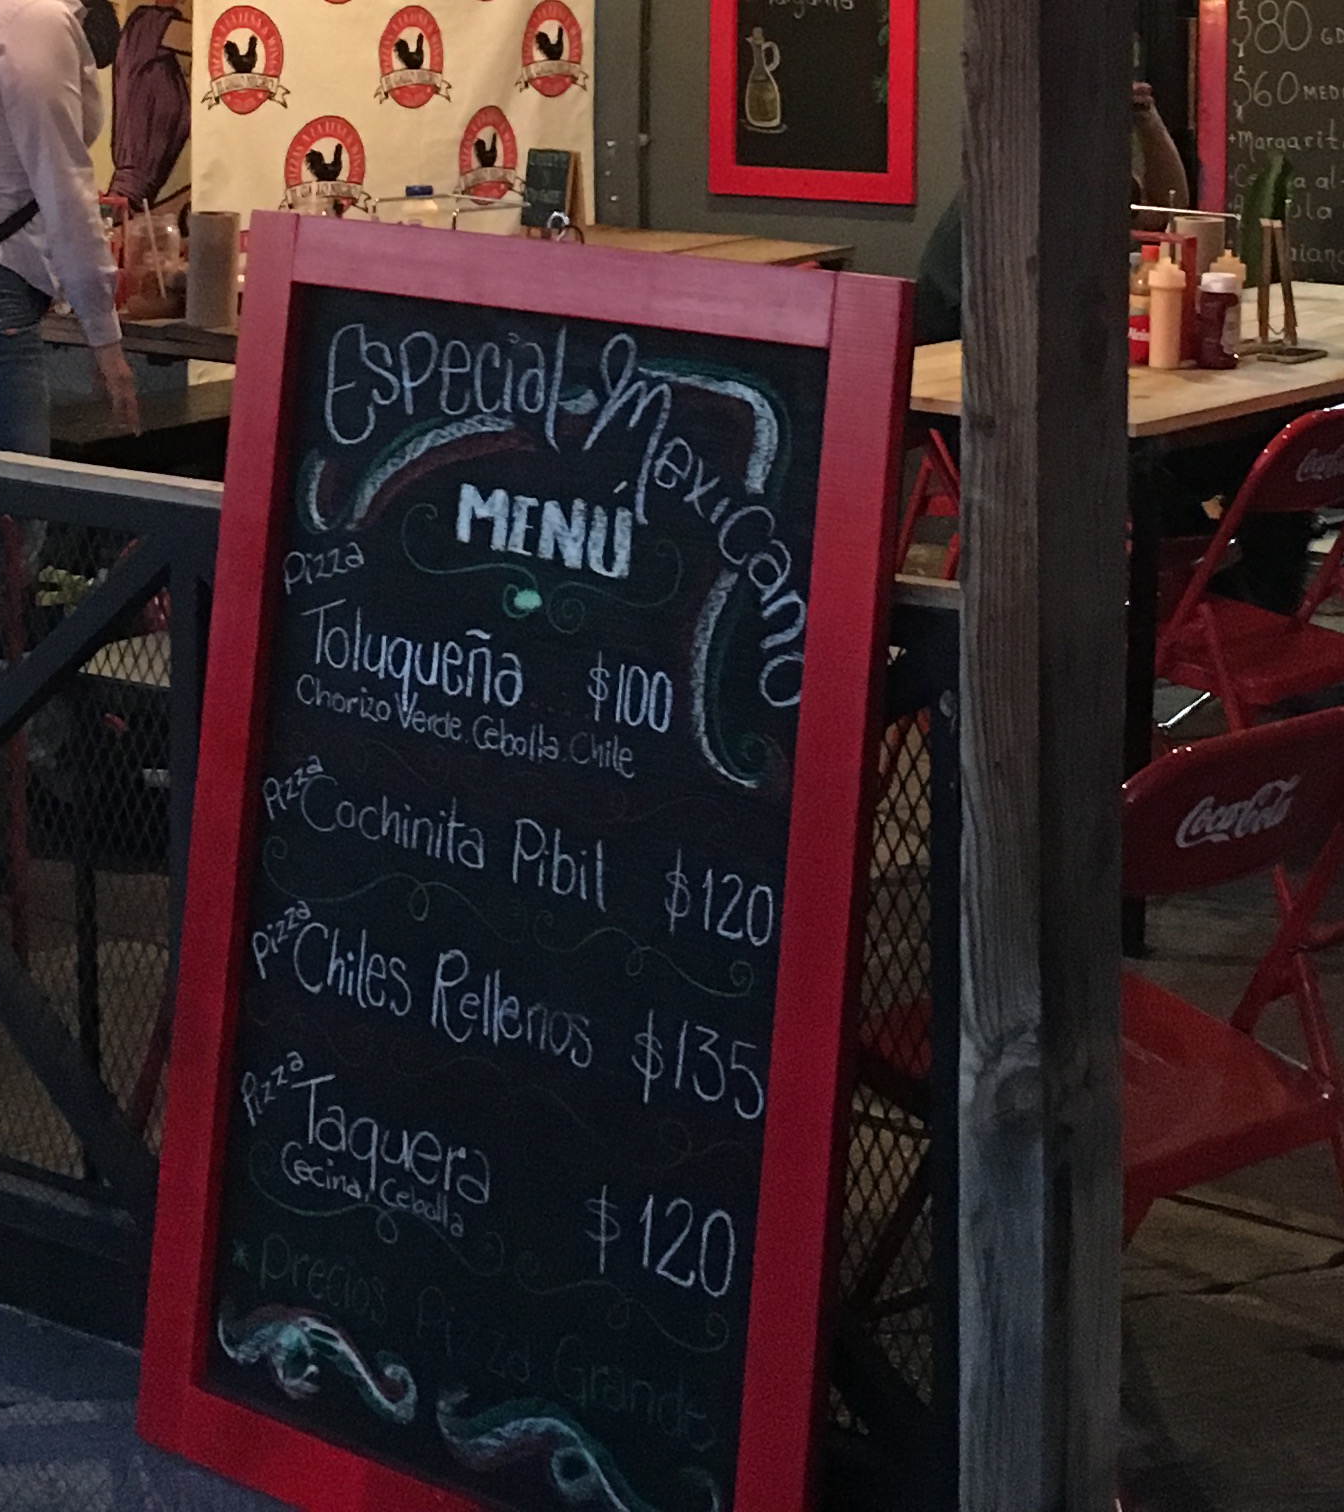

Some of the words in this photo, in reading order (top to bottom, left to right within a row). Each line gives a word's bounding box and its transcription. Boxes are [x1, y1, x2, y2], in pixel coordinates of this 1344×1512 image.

[1233, 0, 1313, 58] $80
[1233, 64, 1299, 123] $60
[1314, 165, 1337, 191] al
[324, 323, 568, 453] Especial
[456, 479, 634, 579] MENÚ
[300, 597, 525, 714] Toluqueña
[586, 649, 674, 734] $100
[295, 673, 392, 724] Chorizo
[569, 731, 637, 780] Chile
[300, 774, 486, 871] Cochinita
[511, 816, 608, 913] Pibil
[664, 846, 775, 948] $120
[292, 921, 413, 1017] Chiles
[431, 948, 595, 1069] Rellenos
[632, 1007, 766, 1121] $135
[289, 1073, 492, 1205] Taquera
[585, 1184, 737, 1298] $120
[378, 1182, 466, 1239] Cebolla
